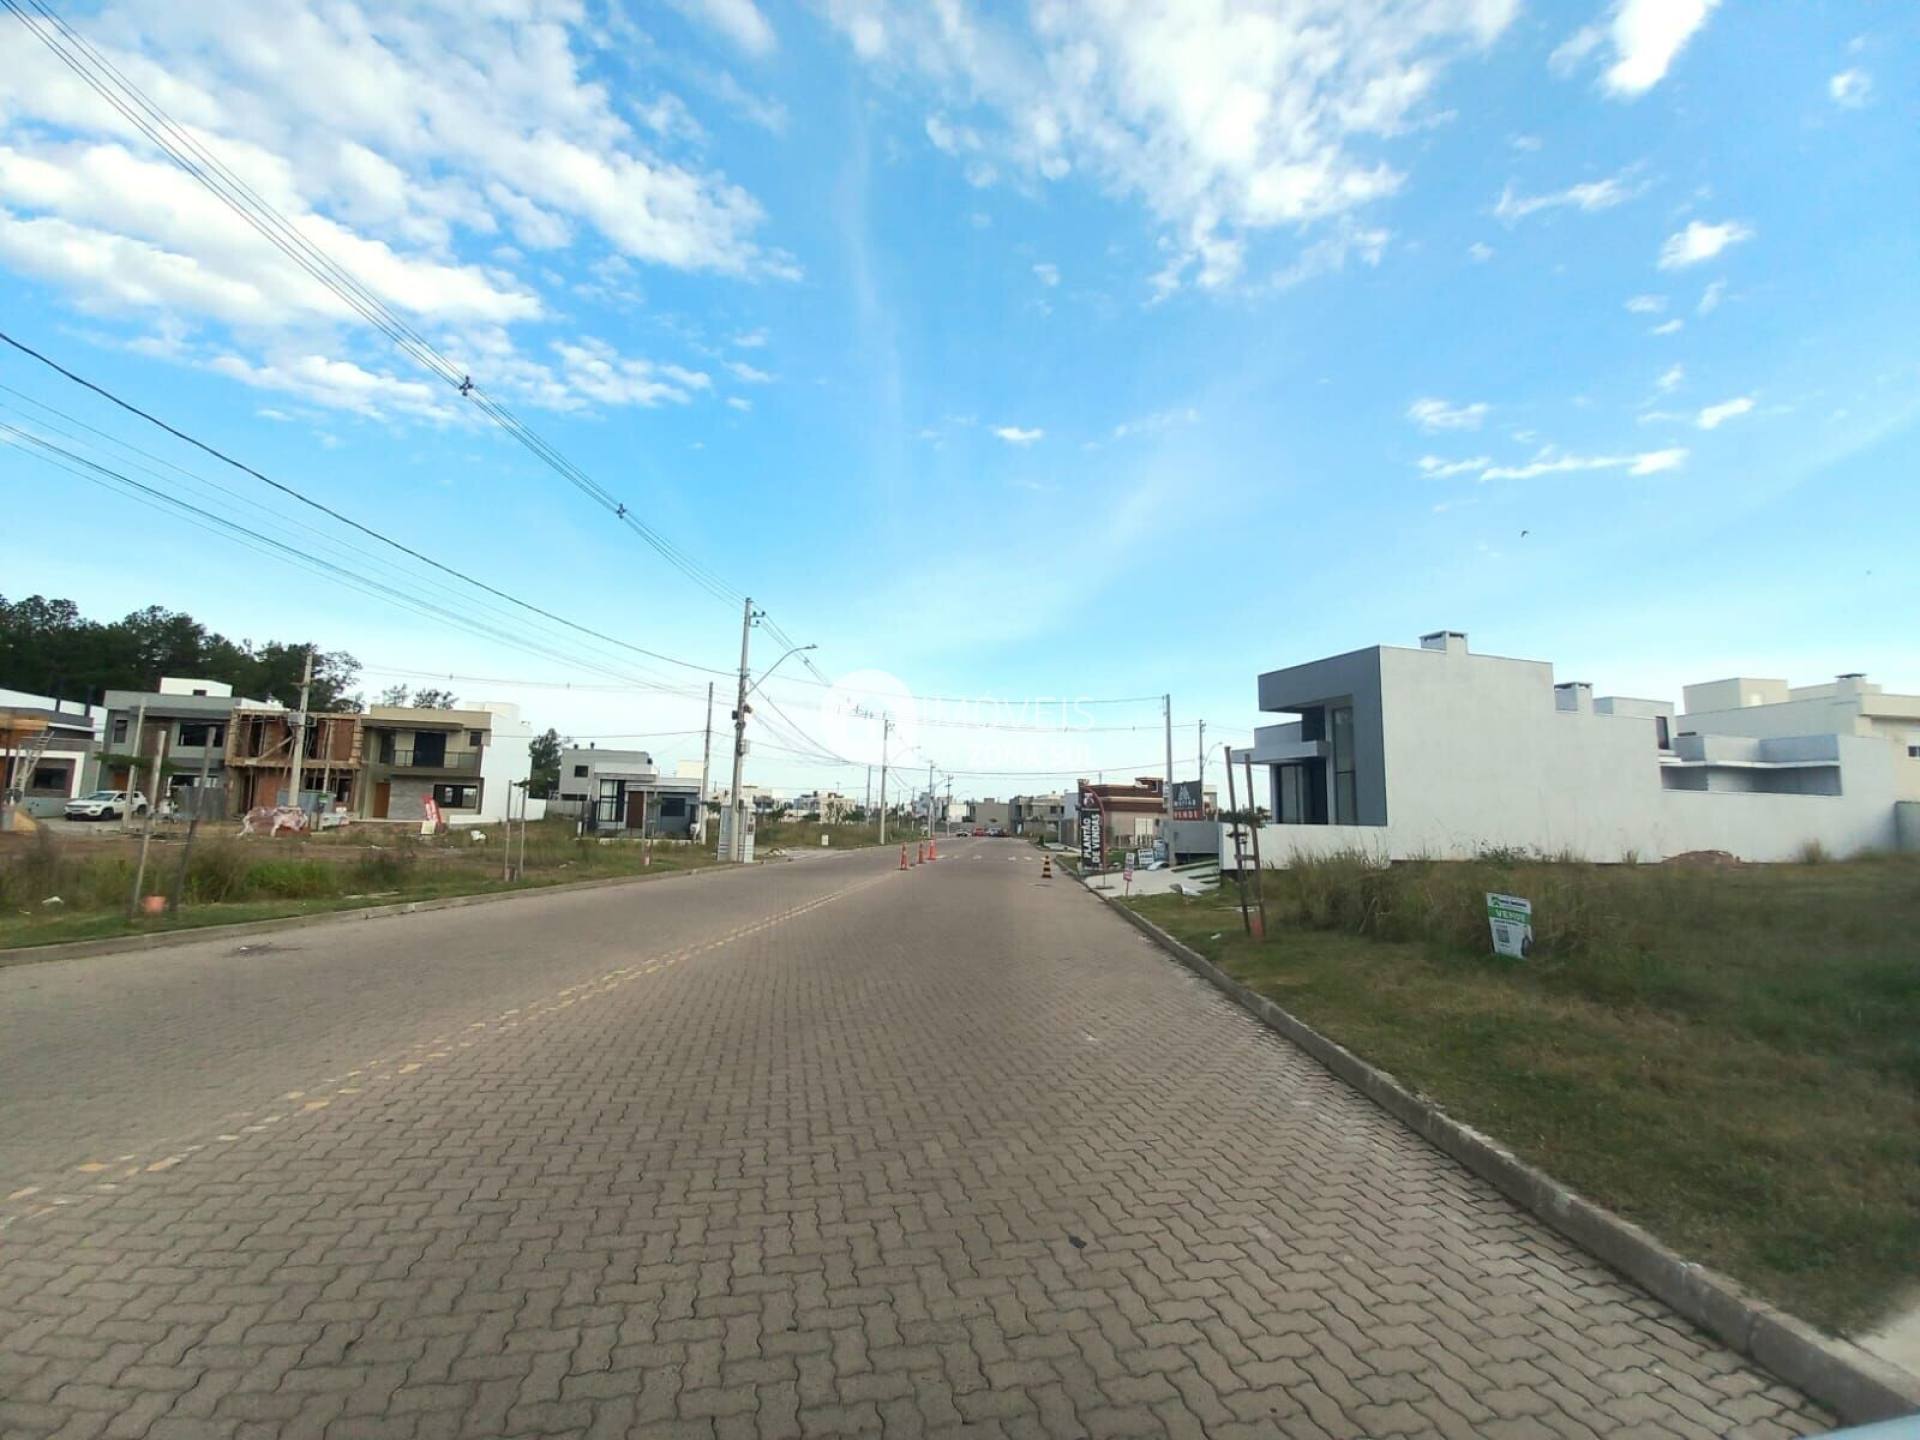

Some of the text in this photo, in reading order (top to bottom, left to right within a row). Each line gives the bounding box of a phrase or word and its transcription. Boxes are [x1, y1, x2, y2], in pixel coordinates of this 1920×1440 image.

[1080, 817, 1092, 858] PLANTÃO
[1091, 814, 1100, 849] VENDAS
[1092, 851, 1101, 863] DE
